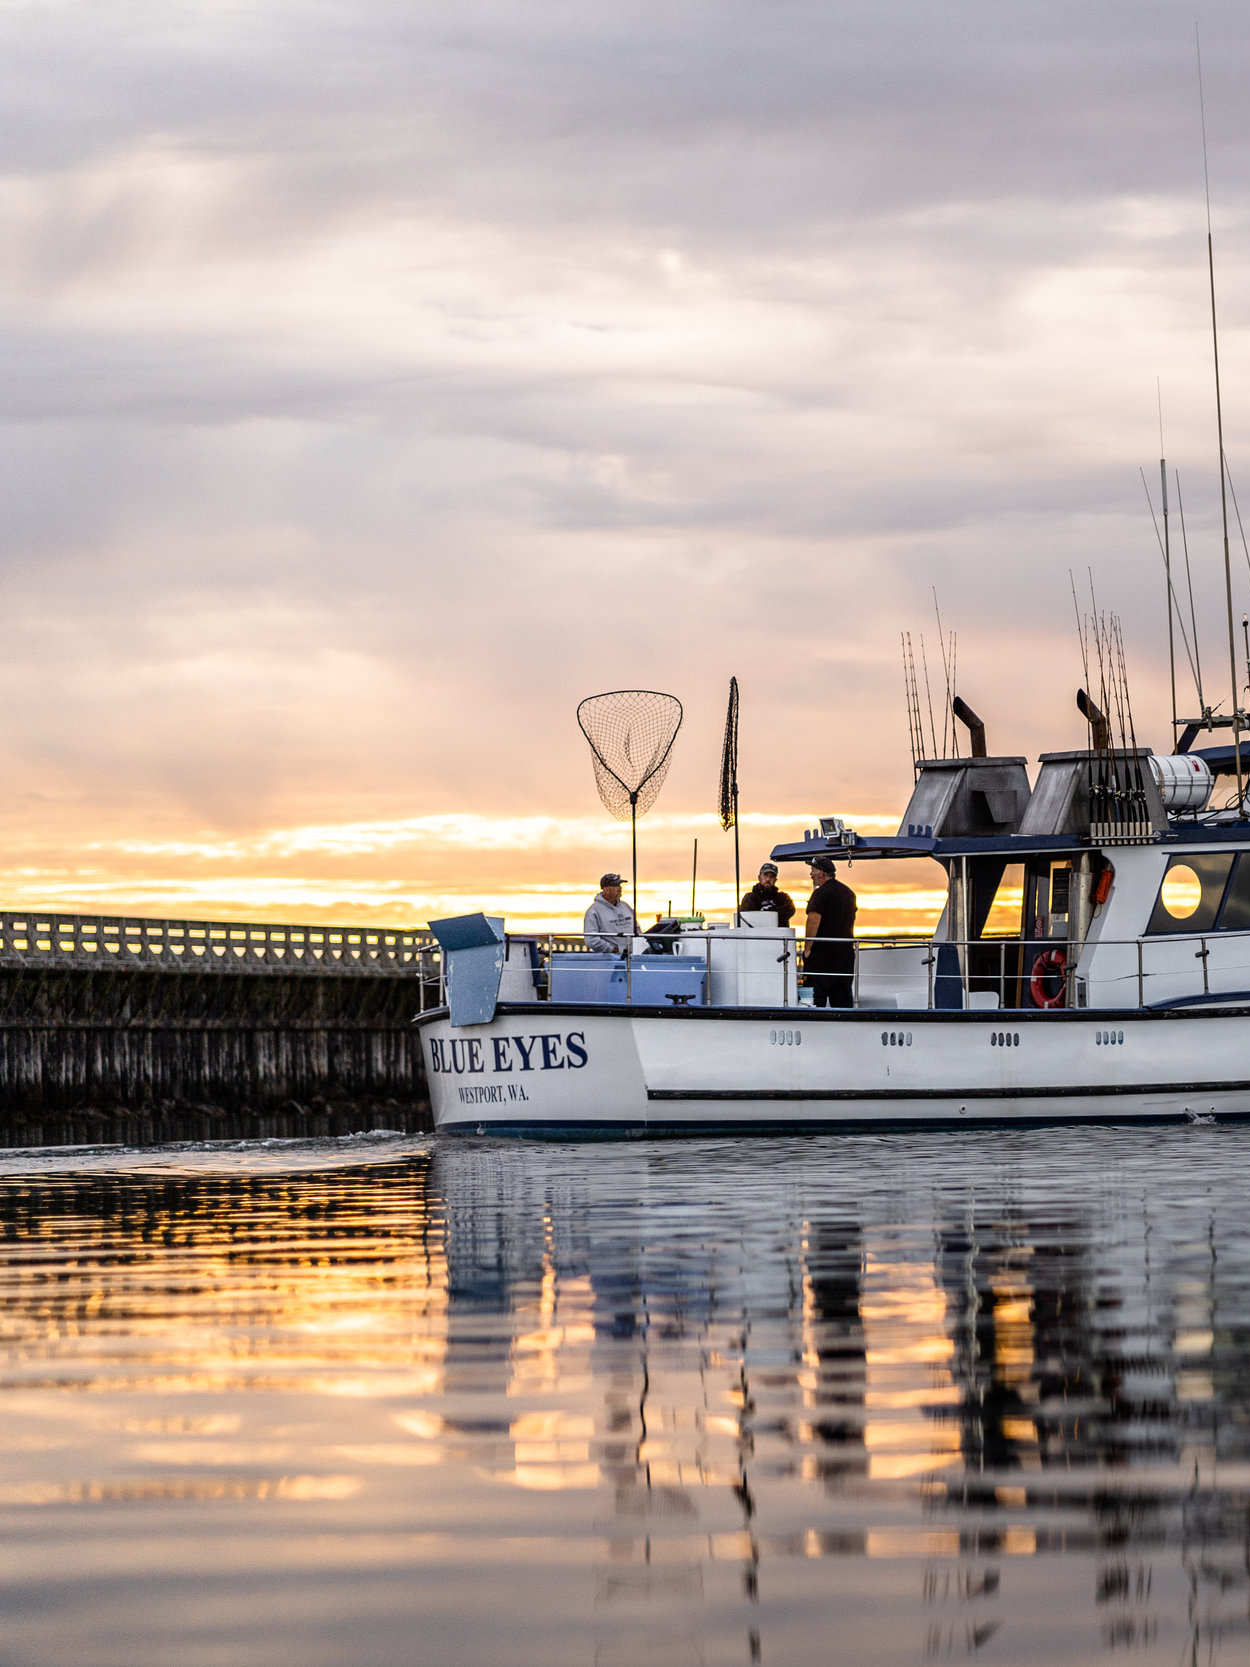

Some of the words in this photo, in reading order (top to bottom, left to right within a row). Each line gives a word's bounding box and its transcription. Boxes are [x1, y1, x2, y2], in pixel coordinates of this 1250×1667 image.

[429, 1038, 485, 1074] BLUE
[490, 1031, 588, 1072] EYES
[458, 1085, 507, 1105] WESTPORT,
[507, 1084, 529, 1101] WA.
